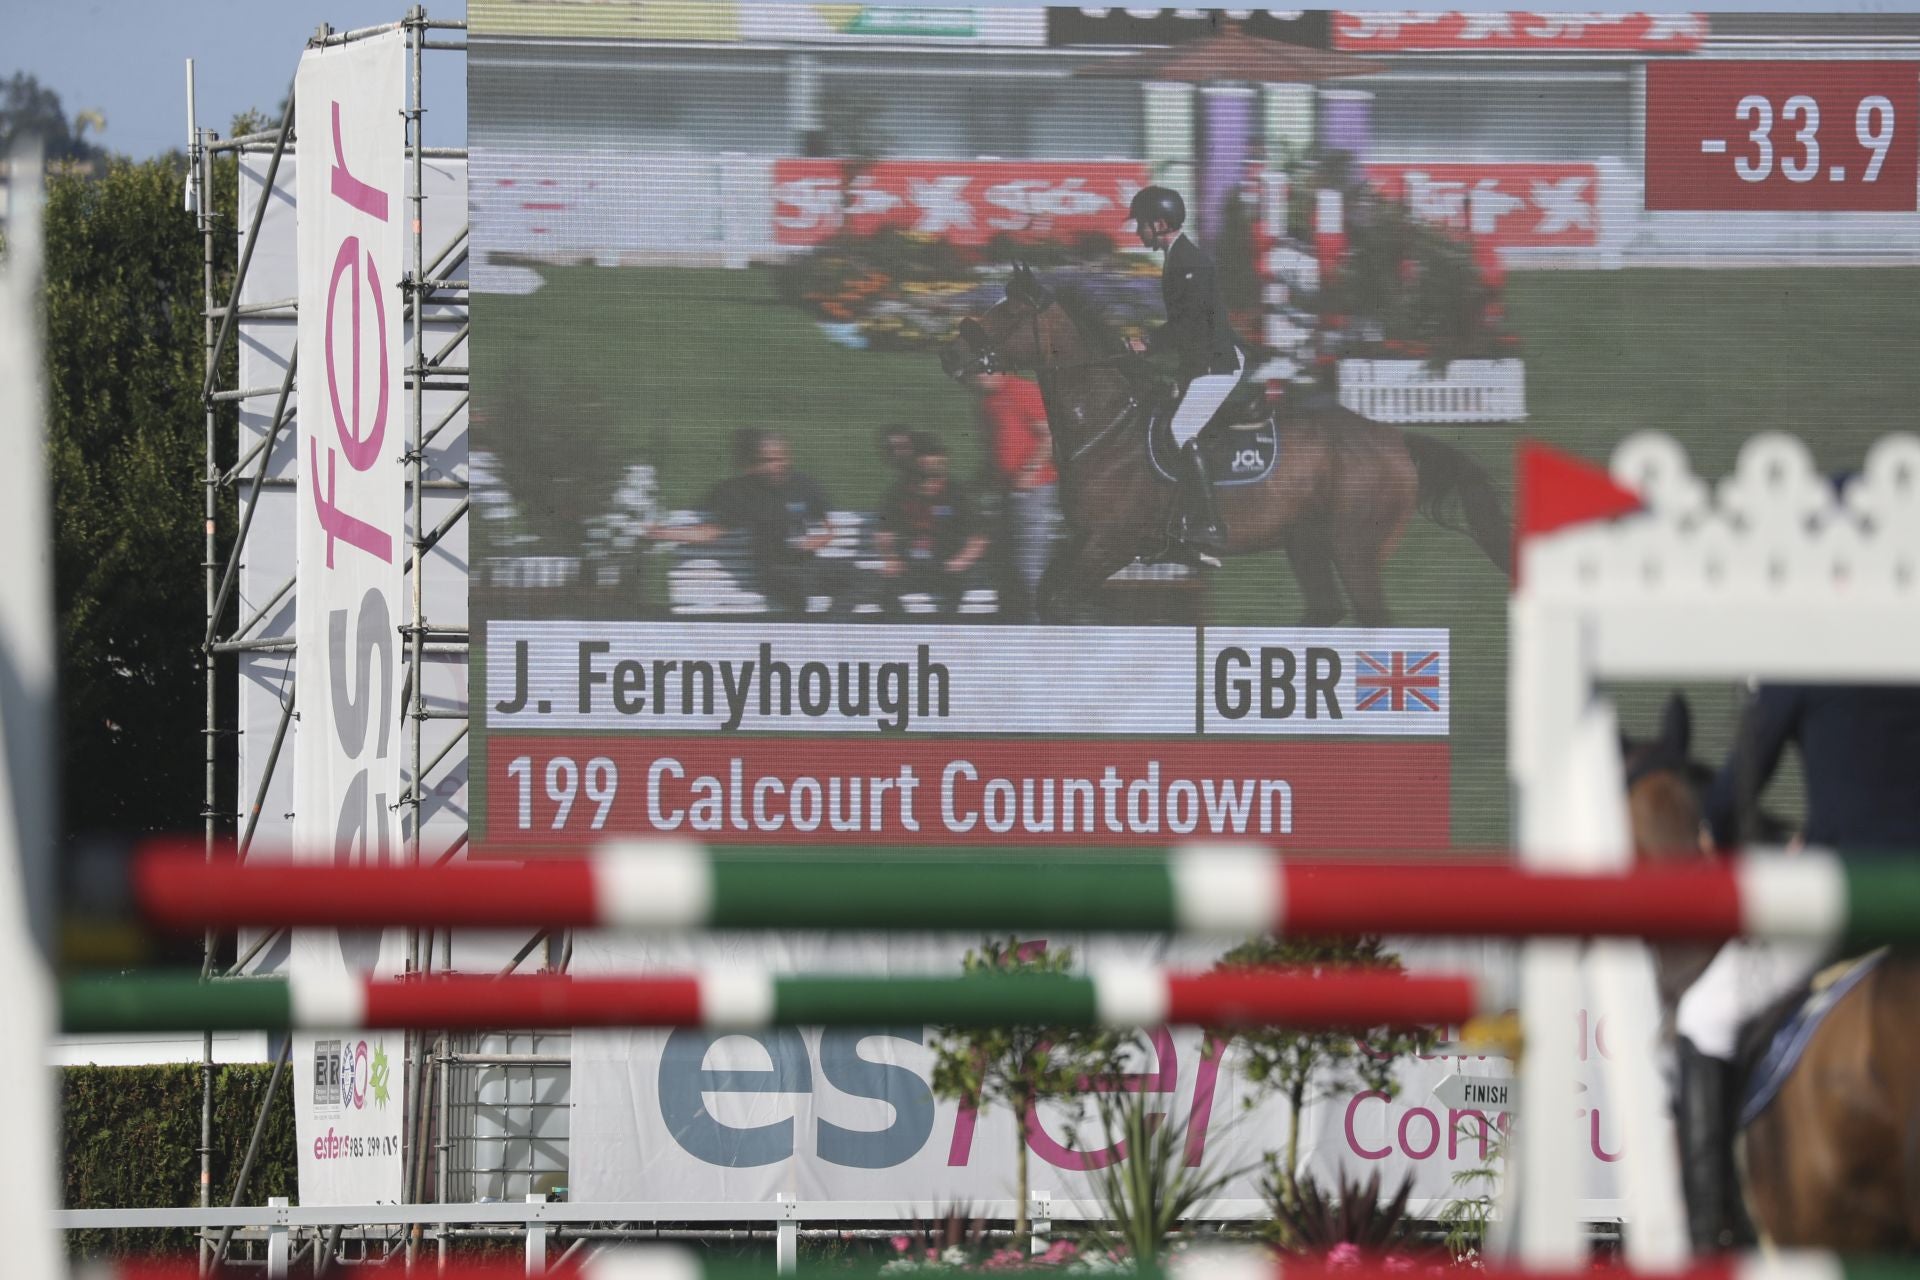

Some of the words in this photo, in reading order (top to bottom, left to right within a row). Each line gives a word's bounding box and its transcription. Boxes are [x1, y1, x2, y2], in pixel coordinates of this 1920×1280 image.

[1701, 94, 1895, 182] -33.9
[494, 639, 552, 714] J.
[578, 640, 949, 732] Fernyhough
[1214, 646, 1343, 719] GBR
[507, 756, 618, 830] 199
[646, 757, 919, 831] Calcourt
[940, 759, 1292, 833] Countdown
[1464, 1084, 1508, 1104] FINISH
